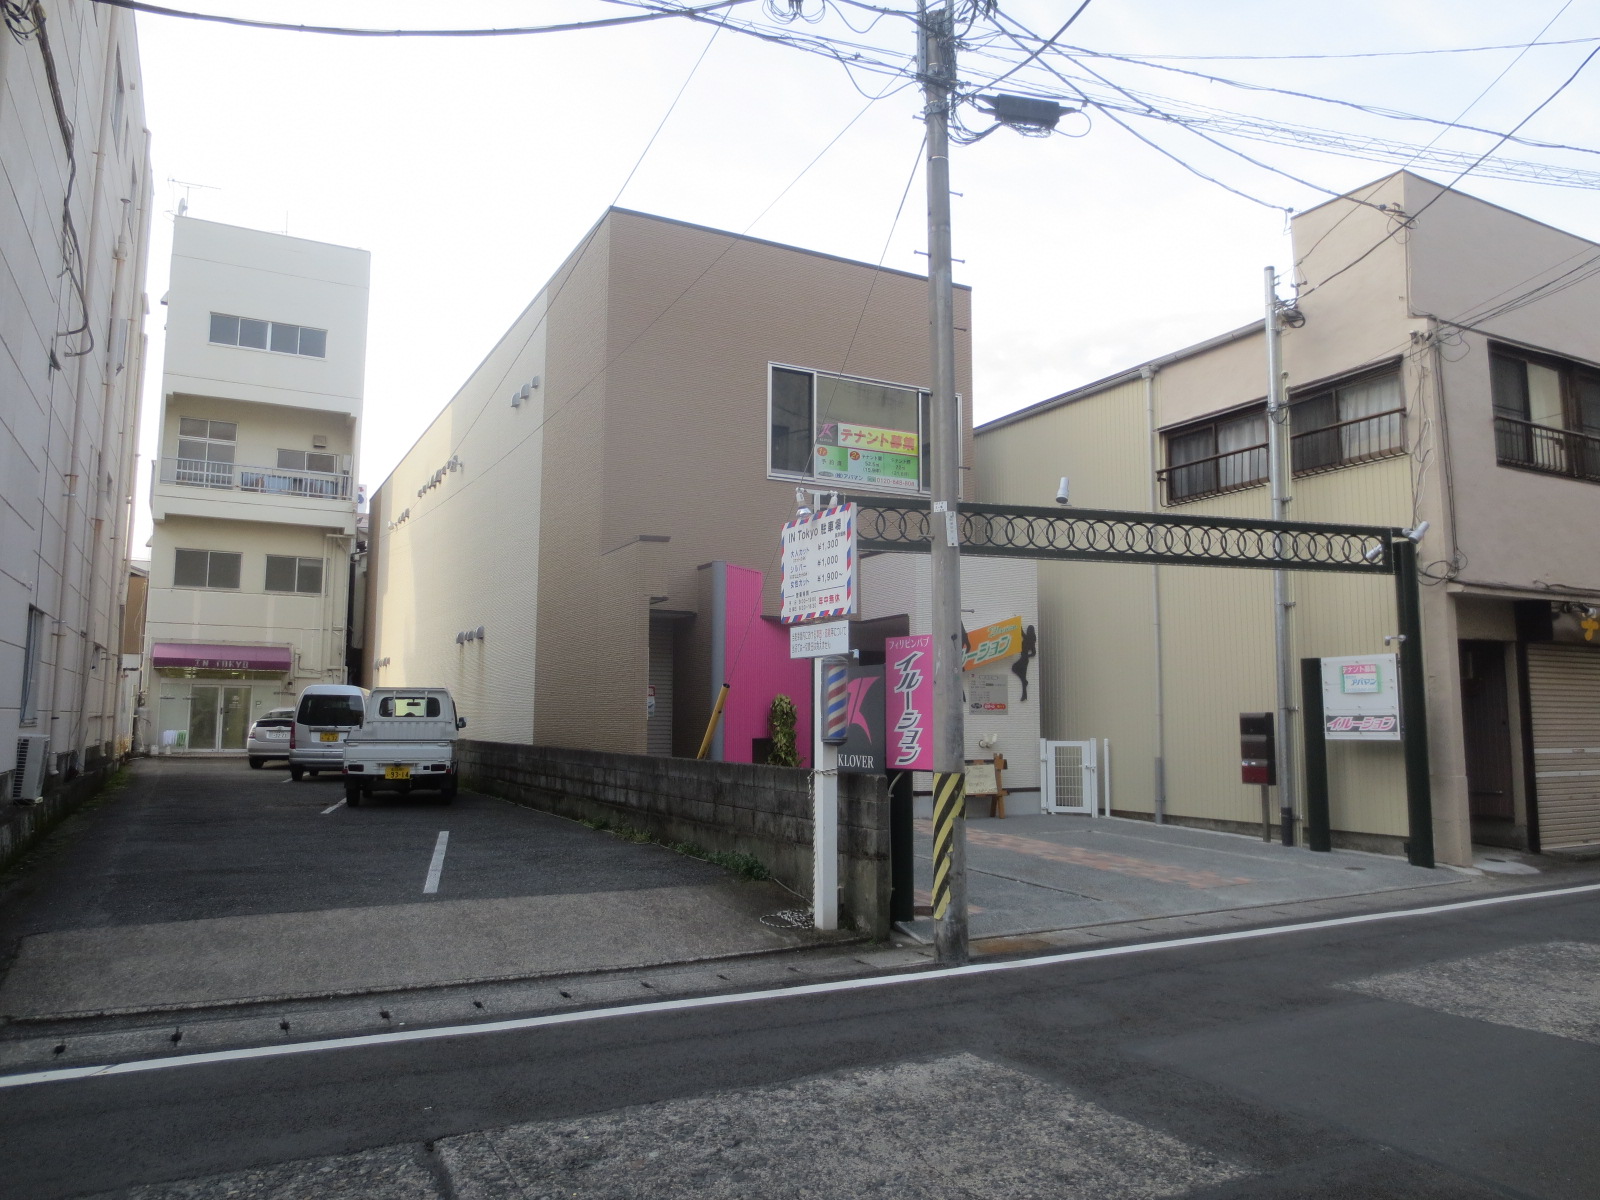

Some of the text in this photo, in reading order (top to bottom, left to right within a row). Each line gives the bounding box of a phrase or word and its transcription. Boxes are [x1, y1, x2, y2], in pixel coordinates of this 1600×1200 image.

[840, 428, 914, 450] テナント募集
[788, 532, 796, 544] IN
[797, 527, 819, 541] Tokyo
[820, 518, 842, 535] 駐車場
[817, 539, 839, 551] ¥1,300
[817, 555, 839, 567] ¥1,000
[818, 593, 841, 605] 年中無休
[888, 637, 930, 650] フィリピンパブ
[194, 658, 249, 669] IN TOKYO
[1351, 678, 1377, 686] アパマン
[894, 650, 925, 766] イルーション
[1327, 716, 1397, 731] イルーション
[838, 754, 874, 769] KLOVER
